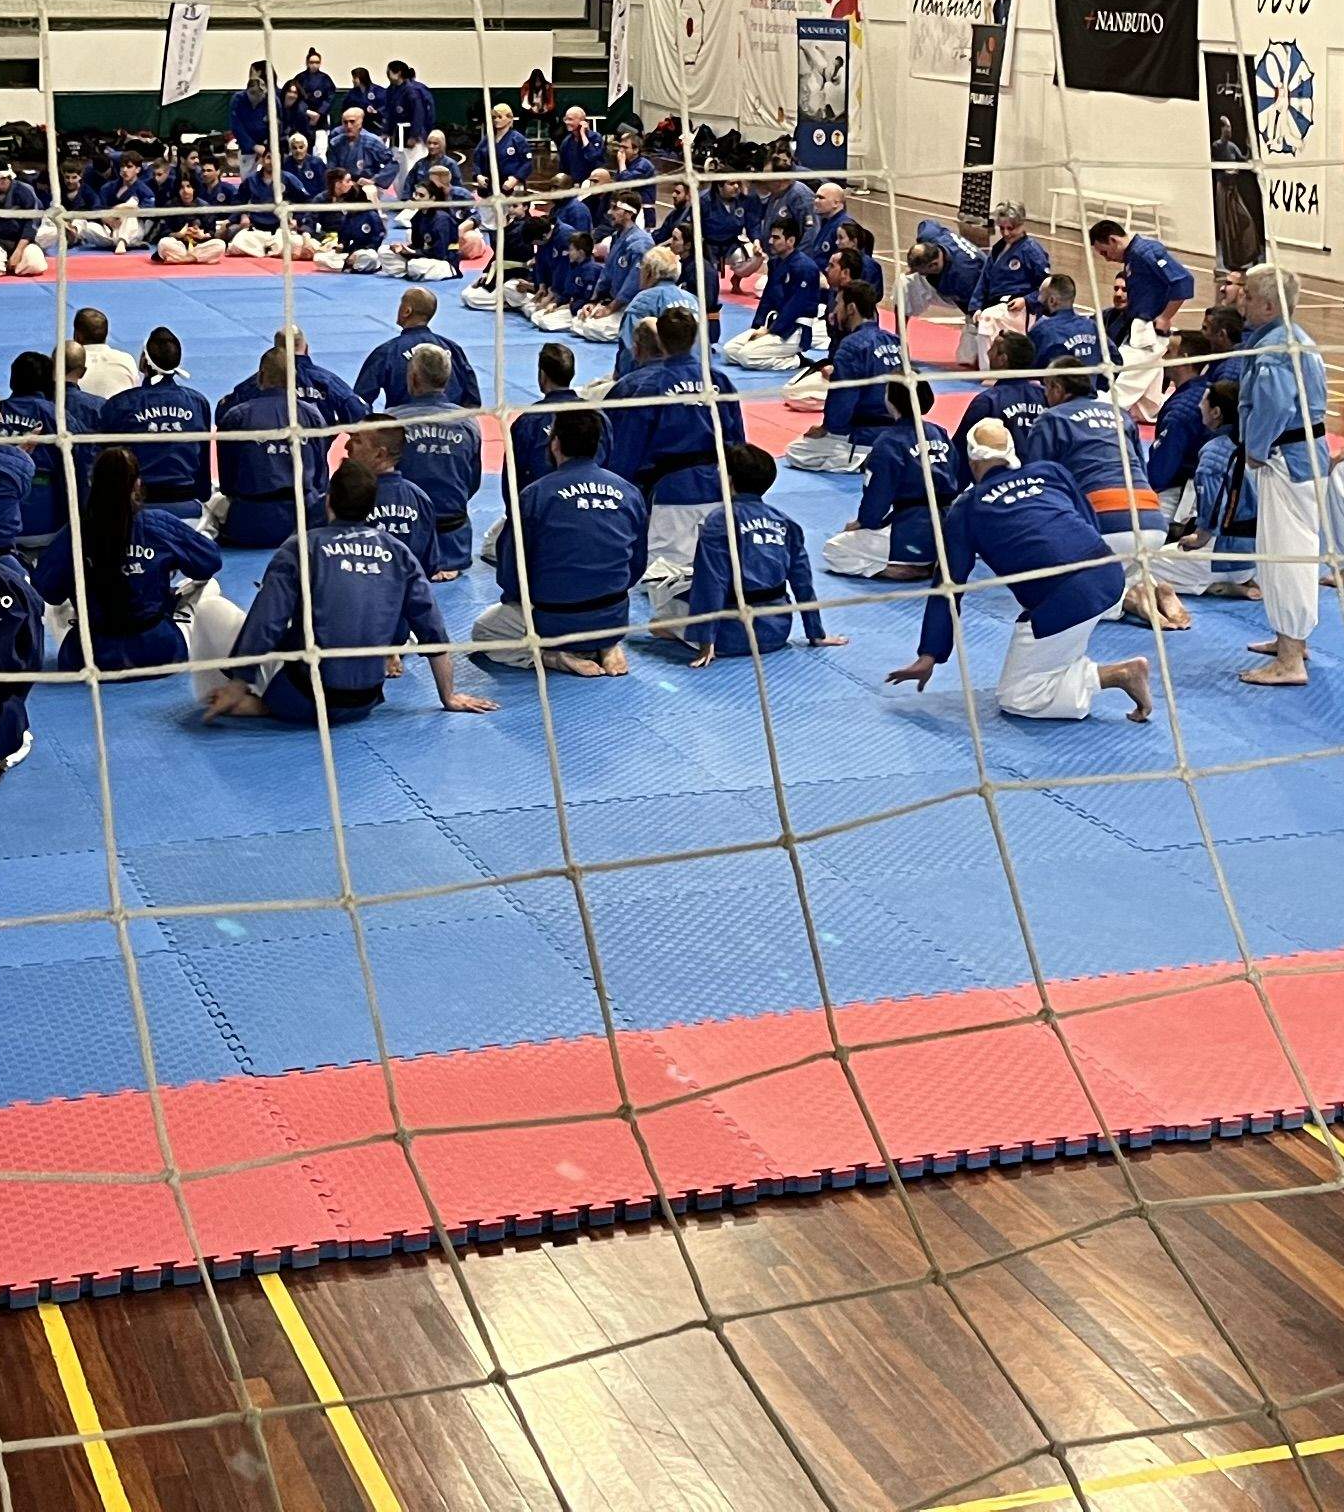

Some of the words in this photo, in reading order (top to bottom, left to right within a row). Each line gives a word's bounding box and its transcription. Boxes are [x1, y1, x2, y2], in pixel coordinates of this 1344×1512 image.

[134, 406, 193, 423] NANBUDO
[405, 425, 463, 444] NANBUDO
[558, 482, 624, 501] NANBUDO
[322, 543, 394, 563] NANBUDO
